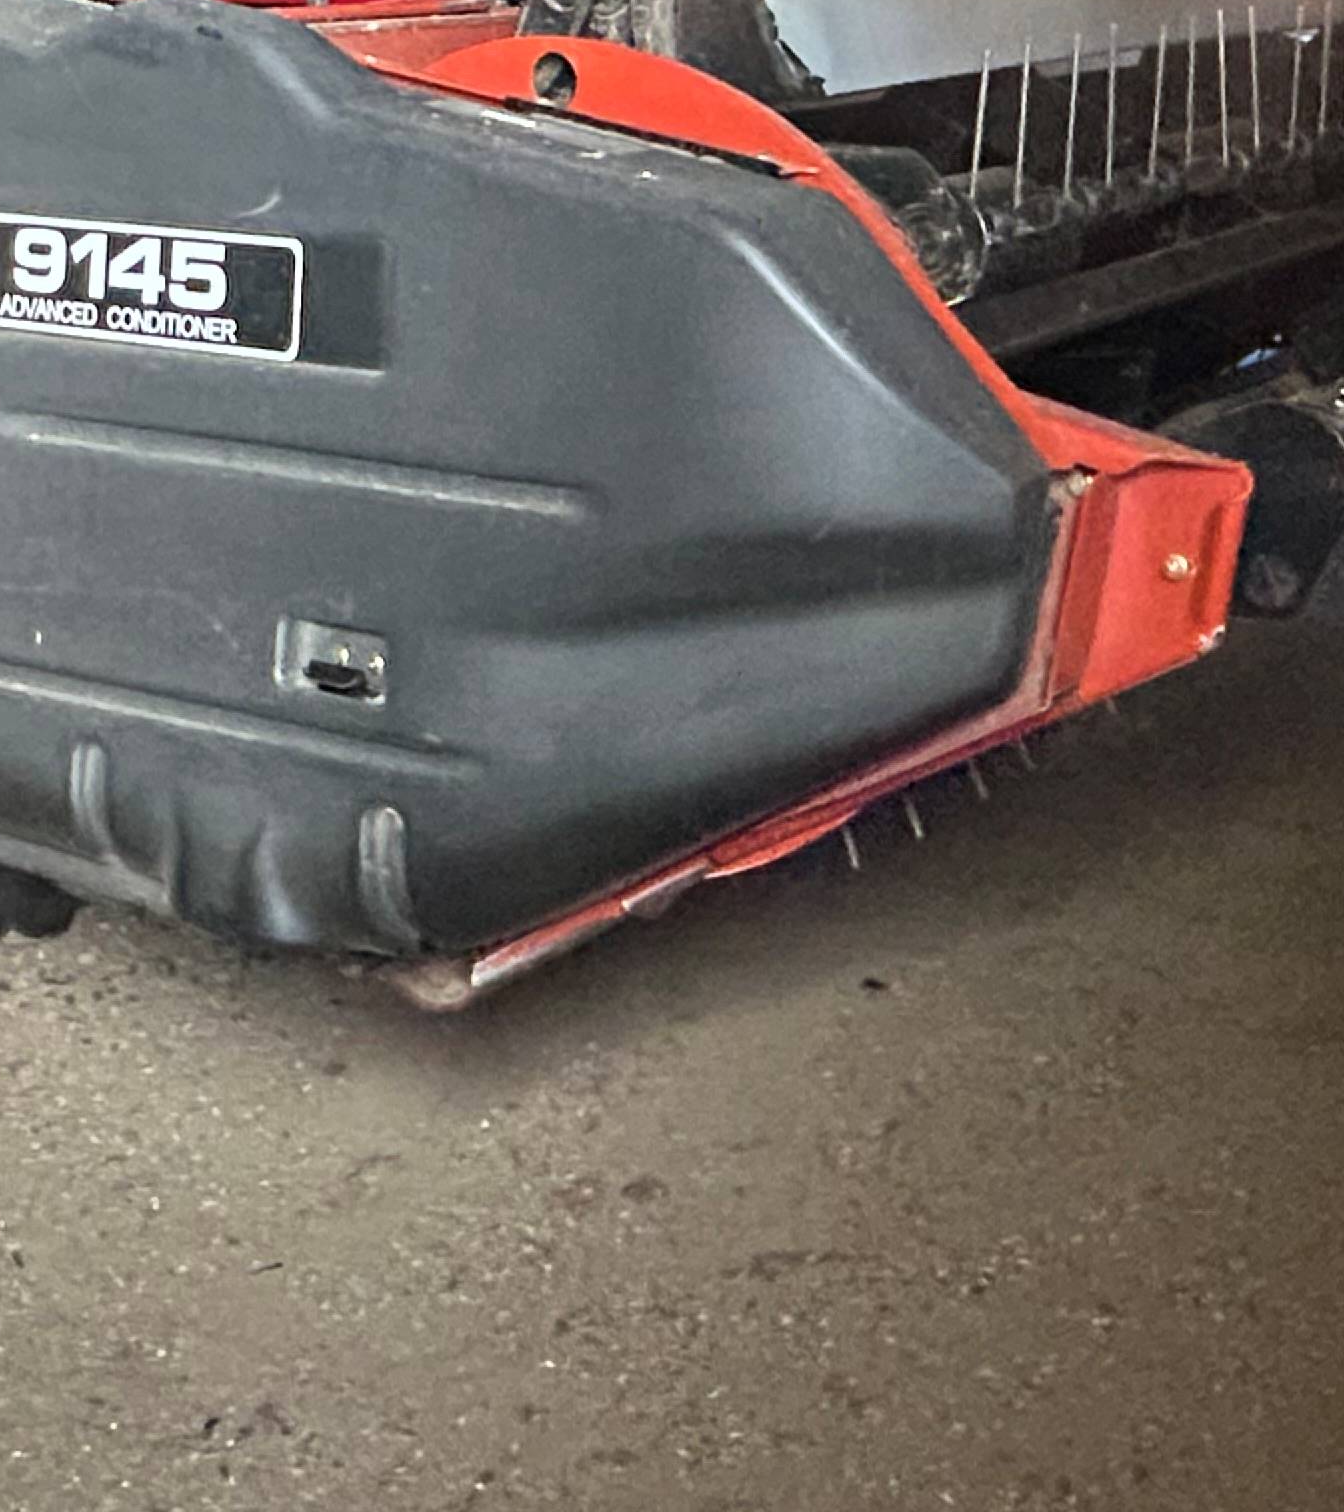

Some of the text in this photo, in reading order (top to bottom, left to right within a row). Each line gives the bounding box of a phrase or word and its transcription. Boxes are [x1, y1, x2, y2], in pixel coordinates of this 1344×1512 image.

[13, 228, 227, 311] 9145
[0, 293, 238, 343] ADVANCED CONDITIONER
